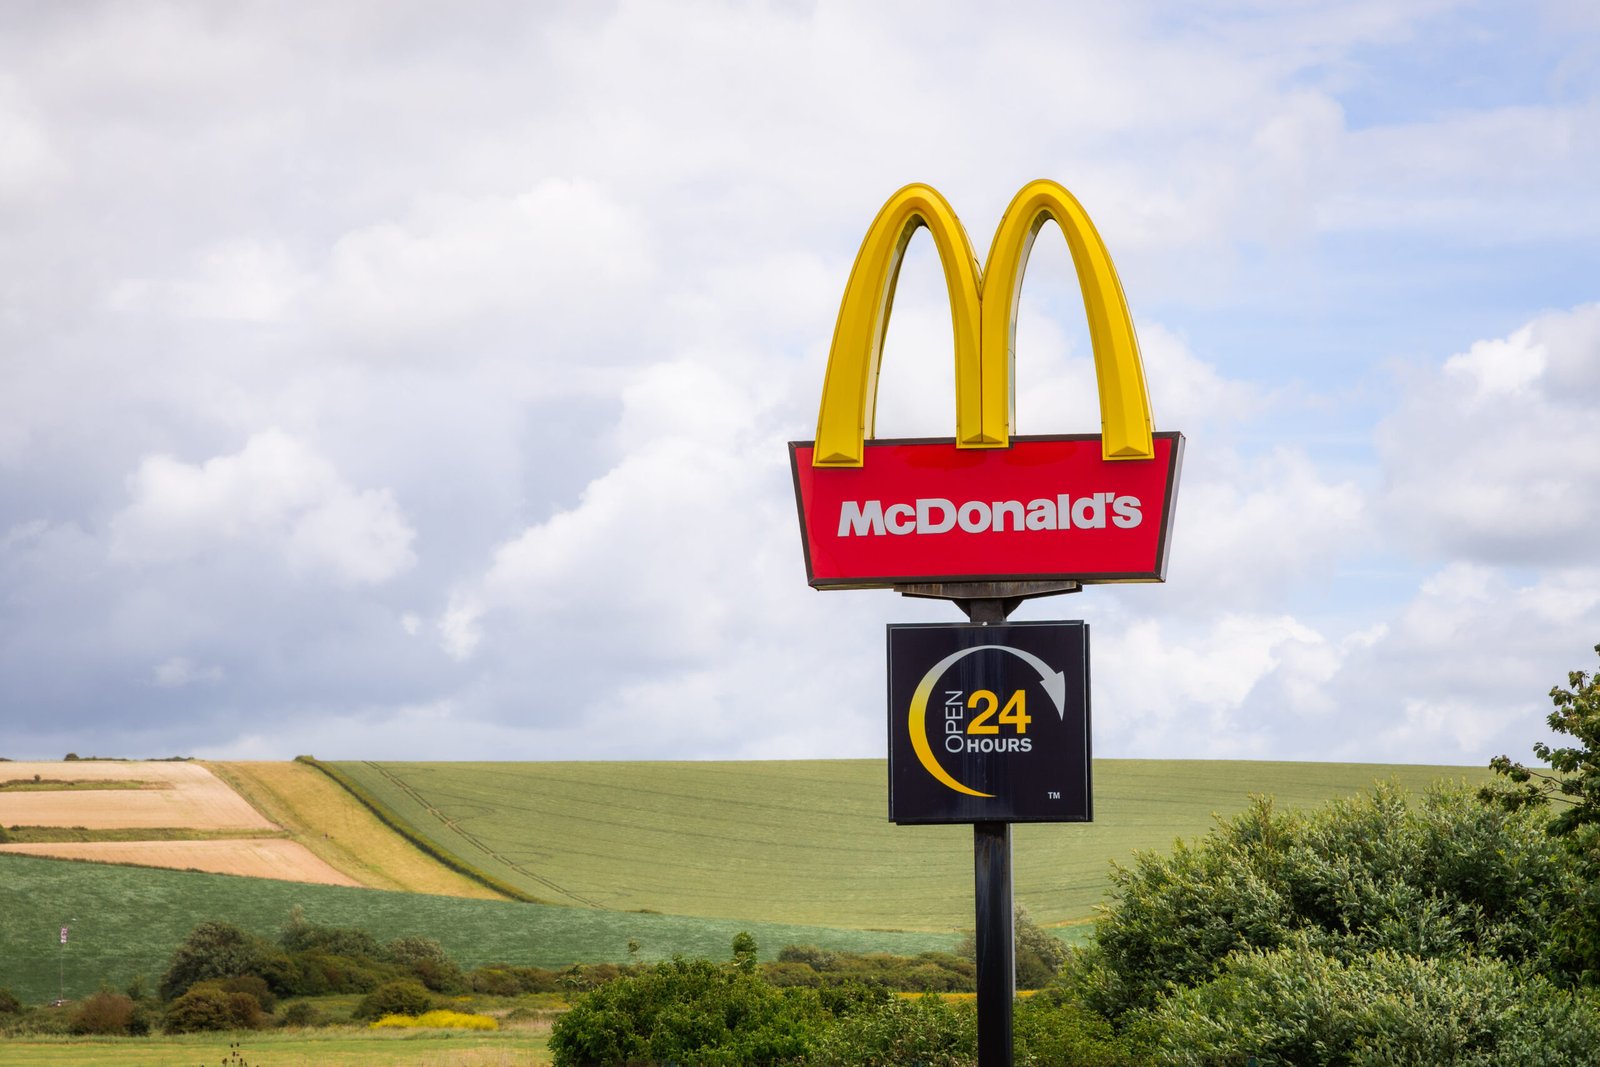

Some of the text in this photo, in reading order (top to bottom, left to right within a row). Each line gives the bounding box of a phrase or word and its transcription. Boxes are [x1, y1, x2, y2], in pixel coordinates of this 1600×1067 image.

[837, 492, 1143, 537] McDonald's
[945, 690, 963, 753] OPEN
[967, 690, 1032, 734] 24
[967, 738, 1033, 753] HOURS
[1047, 791, 1061, 799] TM
